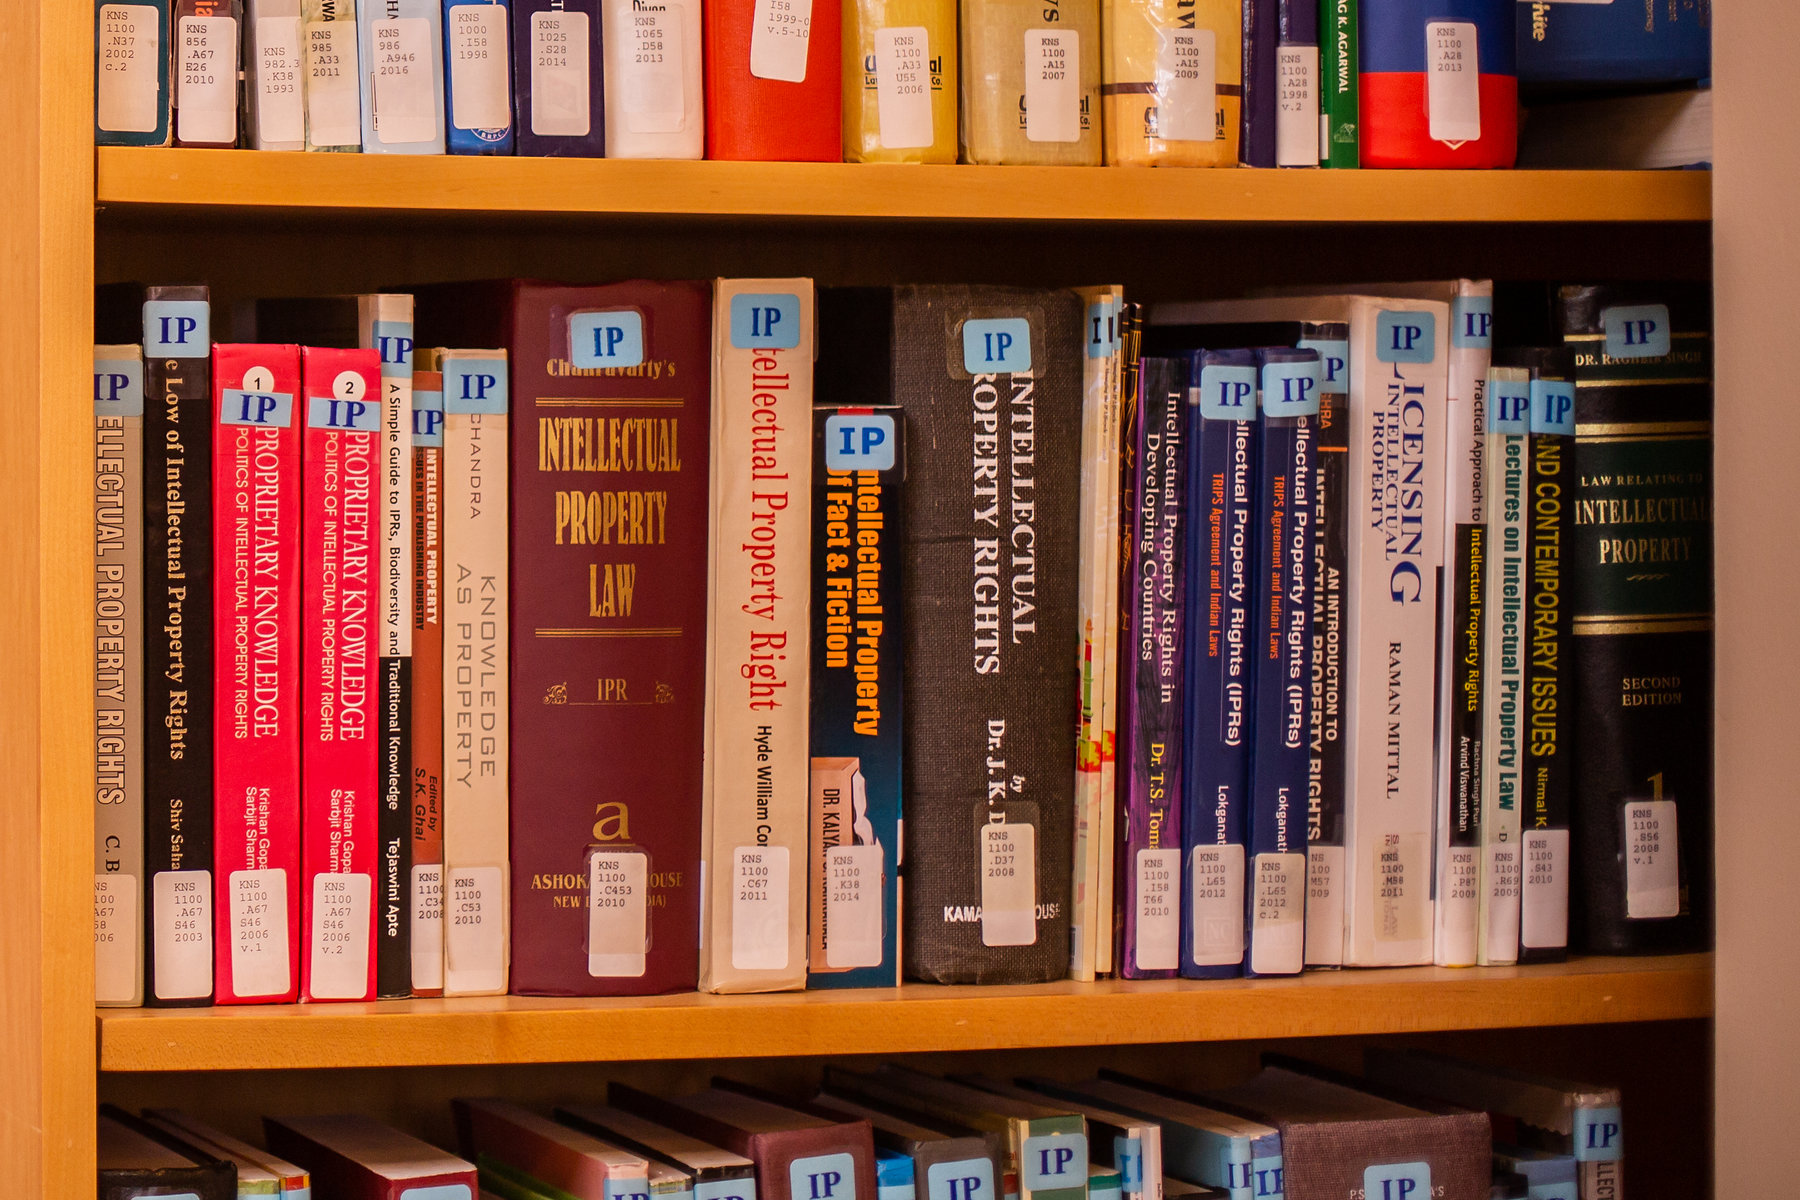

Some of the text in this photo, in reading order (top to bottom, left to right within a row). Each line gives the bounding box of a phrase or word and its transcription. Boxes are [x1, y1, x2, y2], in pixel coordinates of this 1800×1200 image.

[106, 11, 128, 20] KNS
[106, 24, 135, 33] 1100
[106, 37, 135, 46] .N37
[459, 13, 479, 22] KNS
[459, 26, 487, 34] 1000
[1338, 17, 1348, 30] K.
[105, 63, 127, 71] c.2
[106, 49, 134, 59] 2002
[460, 38, 487, 47] .I58
[460, 51, 487, 59] 1998
[1338, 32, 1349, 94] AGARWAL
[158, 316, 196, 344] IP
[593, 326, 624, 357] IP
[751, 307, 781, 337] IP
[1624, 320, 1656, 346] IP
[460, 374, 495, 400] IP
[538, 417, 681, 472] INTELLECTUAL
[839, 426, 886, 455] IP
[1140, 433, 1160, 553] Developing
[1371, 411, 1385, 533] PROPERTY
[1505, 435, 1524, 522] Lectures
[387, 396, 400, 655] Simple Guide IPRs, Biodiversity and
[555, 491, 667, 544] PROPERTY
[164, 430, 187, 761] of Intellectual Property Rights
[234, 428, 249, 739] POLITICS OF INTELLECTUAL PROPERTY RIGHTS
[253, 426, 279, 738] PROPRIETARY KNOWLEDGE
[589, 563, 636, 618] LAW
[740, 491, 789, 712] Property Right
[826, 492, 853, 668] Fact Fiction
[973, 537, 1001, 675] RIGHTS
[96, 564, 126, 805] PROPERTY RIGHTS
[456, 564, 472, 789] AS PROPERTY
[480, 575, 496, 777] KNOWLEDGE
[597, 679, 628, 701] IPR
[853, 620, 882, 736] Property
[386, 660, 400, 810] Traditional Knowledge
[1225, 683, 1242, 747] (IPRs)
[1387, 641, 1402, 799] RAMAN MITTAL
[1530, 677, 1557, 757] ISSUES
[1498, 678, 1520, 811] Property Law
[754, 725, 772, 820] Hyde William
[174, 883, 195, 891] KNS
[387, 839, 400, 936] Tejaswini Apte
[598, 861, 620, 870] KNS
[599, 886, 631, 895] .C453
[176, 908, 203, 917] .A67
[598, 898, 625, 907] 2010
[175, 933, 203, 942] 2003
[1039, 1147, 1073, 1175] IP
